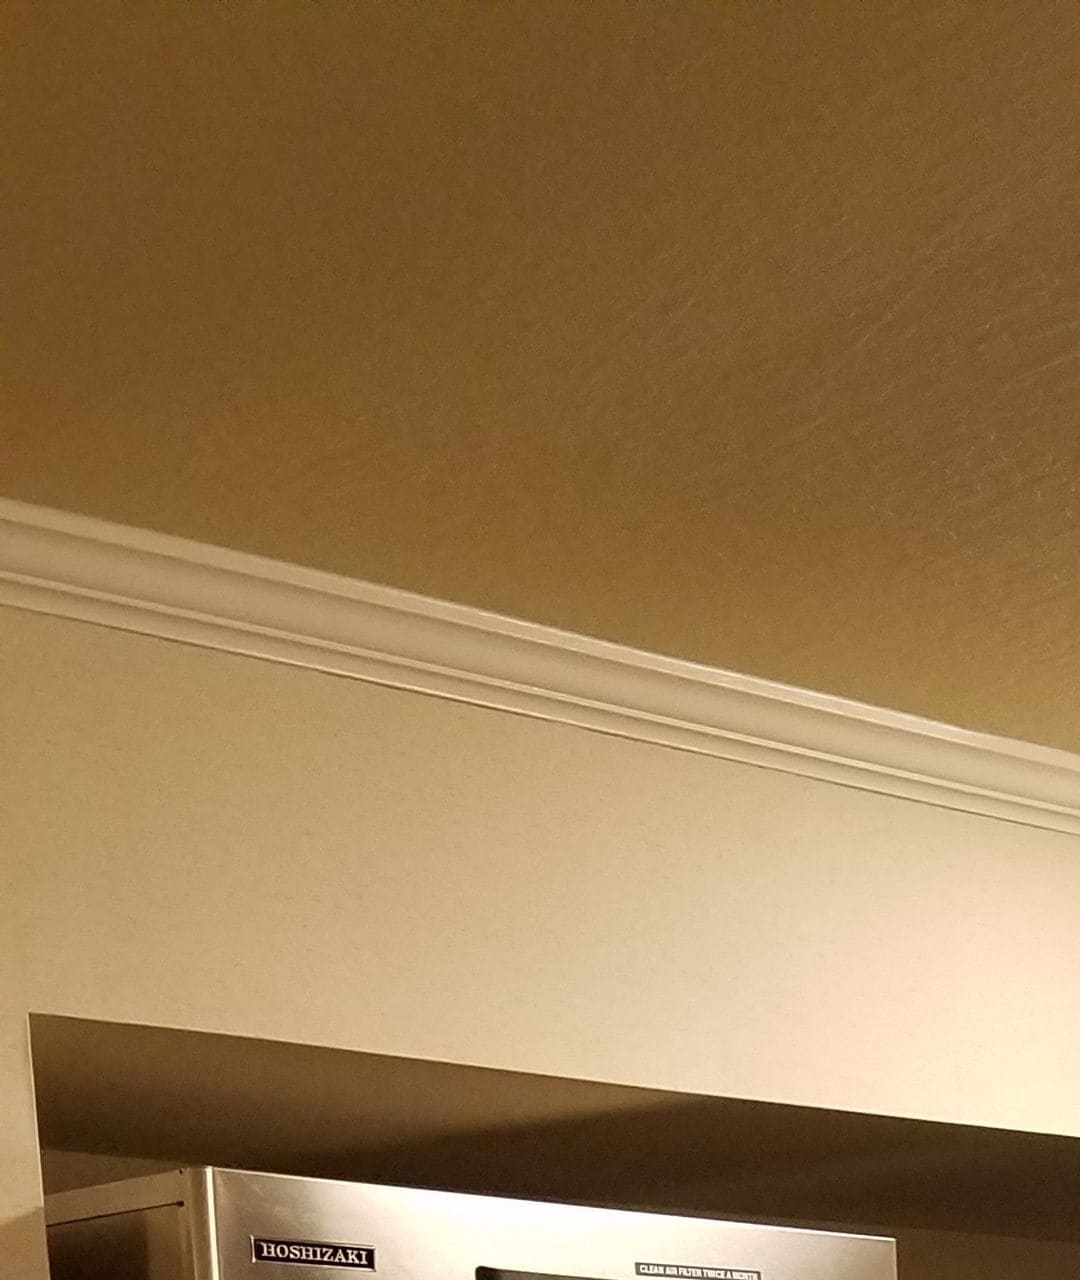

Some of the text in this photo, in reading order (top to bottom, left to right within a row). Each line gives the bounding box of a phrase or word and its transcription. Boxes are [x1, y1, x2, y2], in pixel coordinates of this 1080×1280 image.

[261, 1241, 368, 1265] HOSHIZAKI
[639, 1264, 665, 1274] CLEAN
[679, 1267, 702, 1277] FILTER
